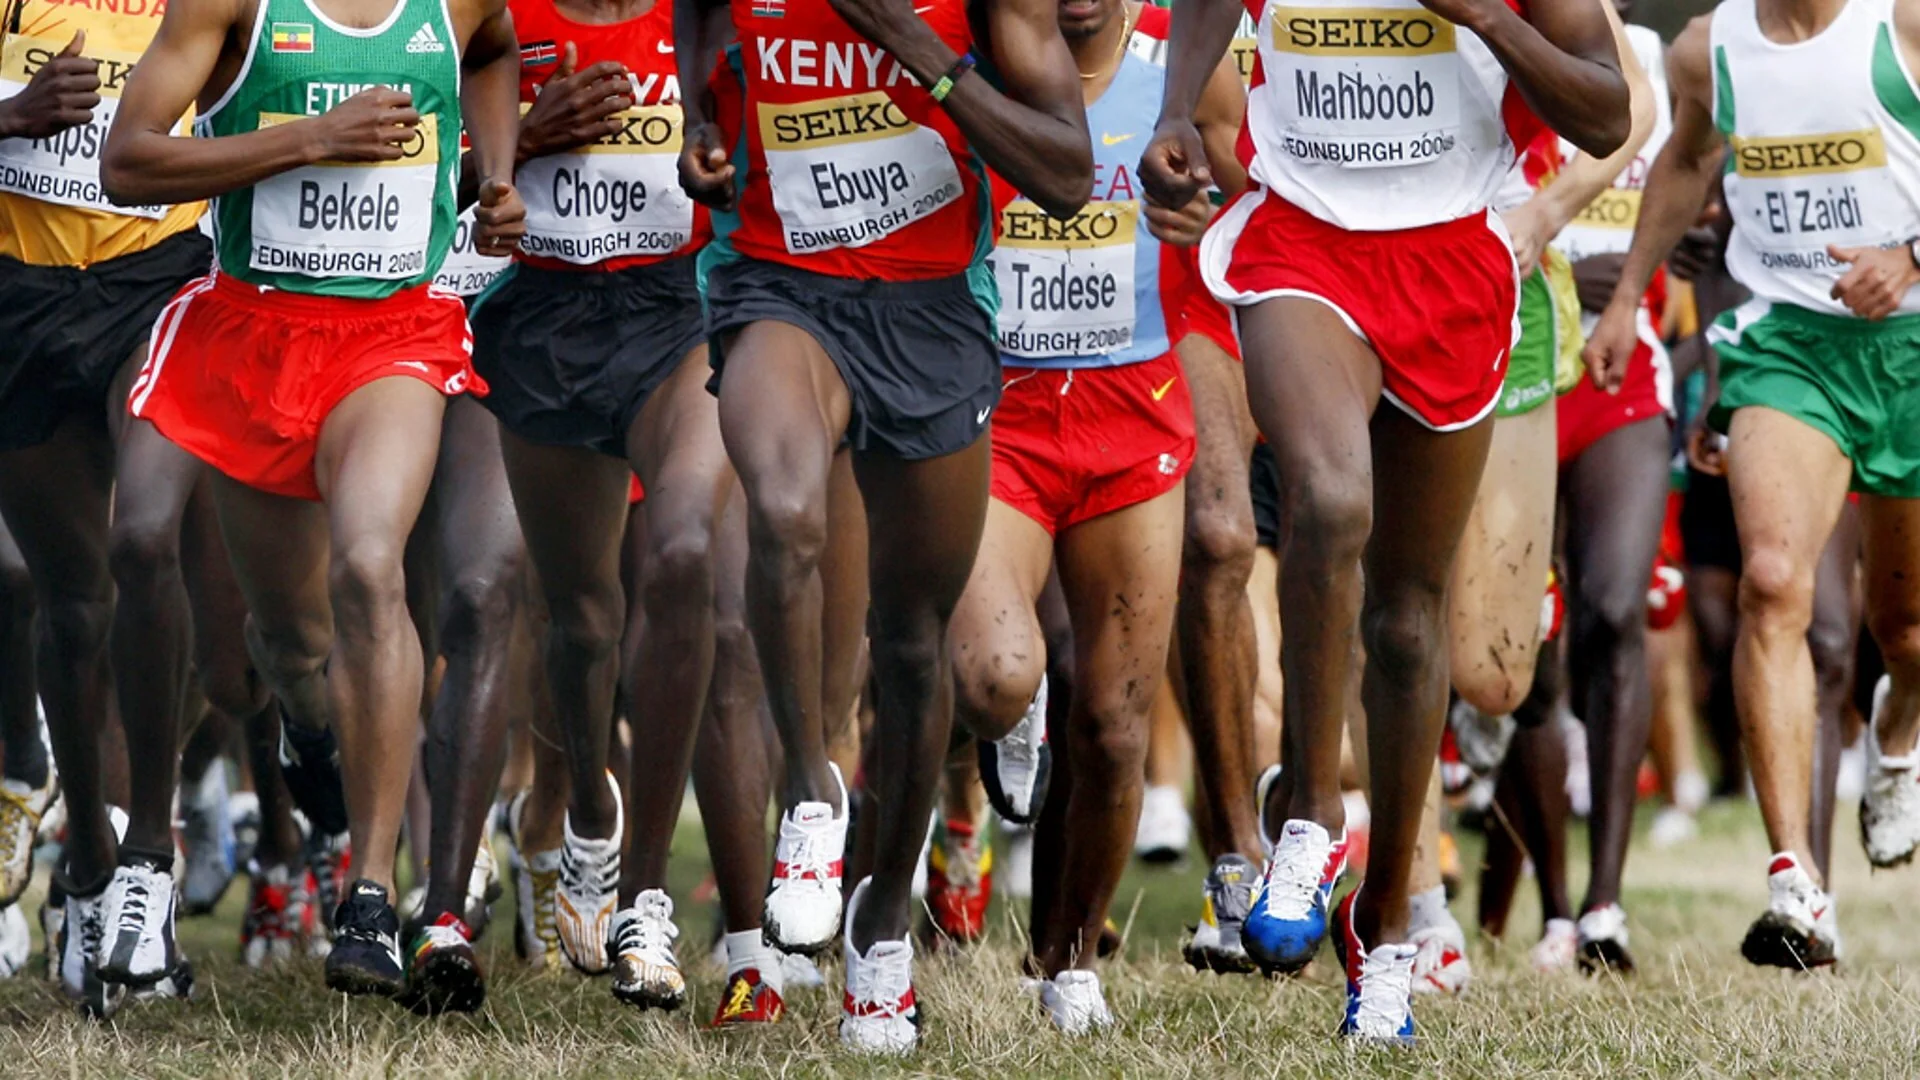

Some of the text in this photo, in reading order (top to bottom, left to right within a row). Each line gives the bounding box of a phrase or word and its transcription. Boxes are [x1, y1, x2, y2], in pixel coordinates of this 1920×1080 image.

[406, 42, 445, 53] adidas
[1289, 18, 1434, 48] SEIKO
[1295, 69, 1434, 120] Mahboob
[774, 101, 910, 143] SEIKO
[1285, 137, 1403, 162] EDINBURGH
[1741, 140, 1865, 171] SEIKO
[298, 180, 400, 232] Bekele
[553, 167, 647, 222] Choge
[810, 161, 909, 209] Ebuya
[790, 207, 909, 249] EDINBURGH
[1766, 187, 1863, 233] El Zaidi
[258, 245, 382, 273] EDINBURGH
[521, 232, 630, 257] EDINBURGH
[1012, 263, 1116, 312] Tadese
